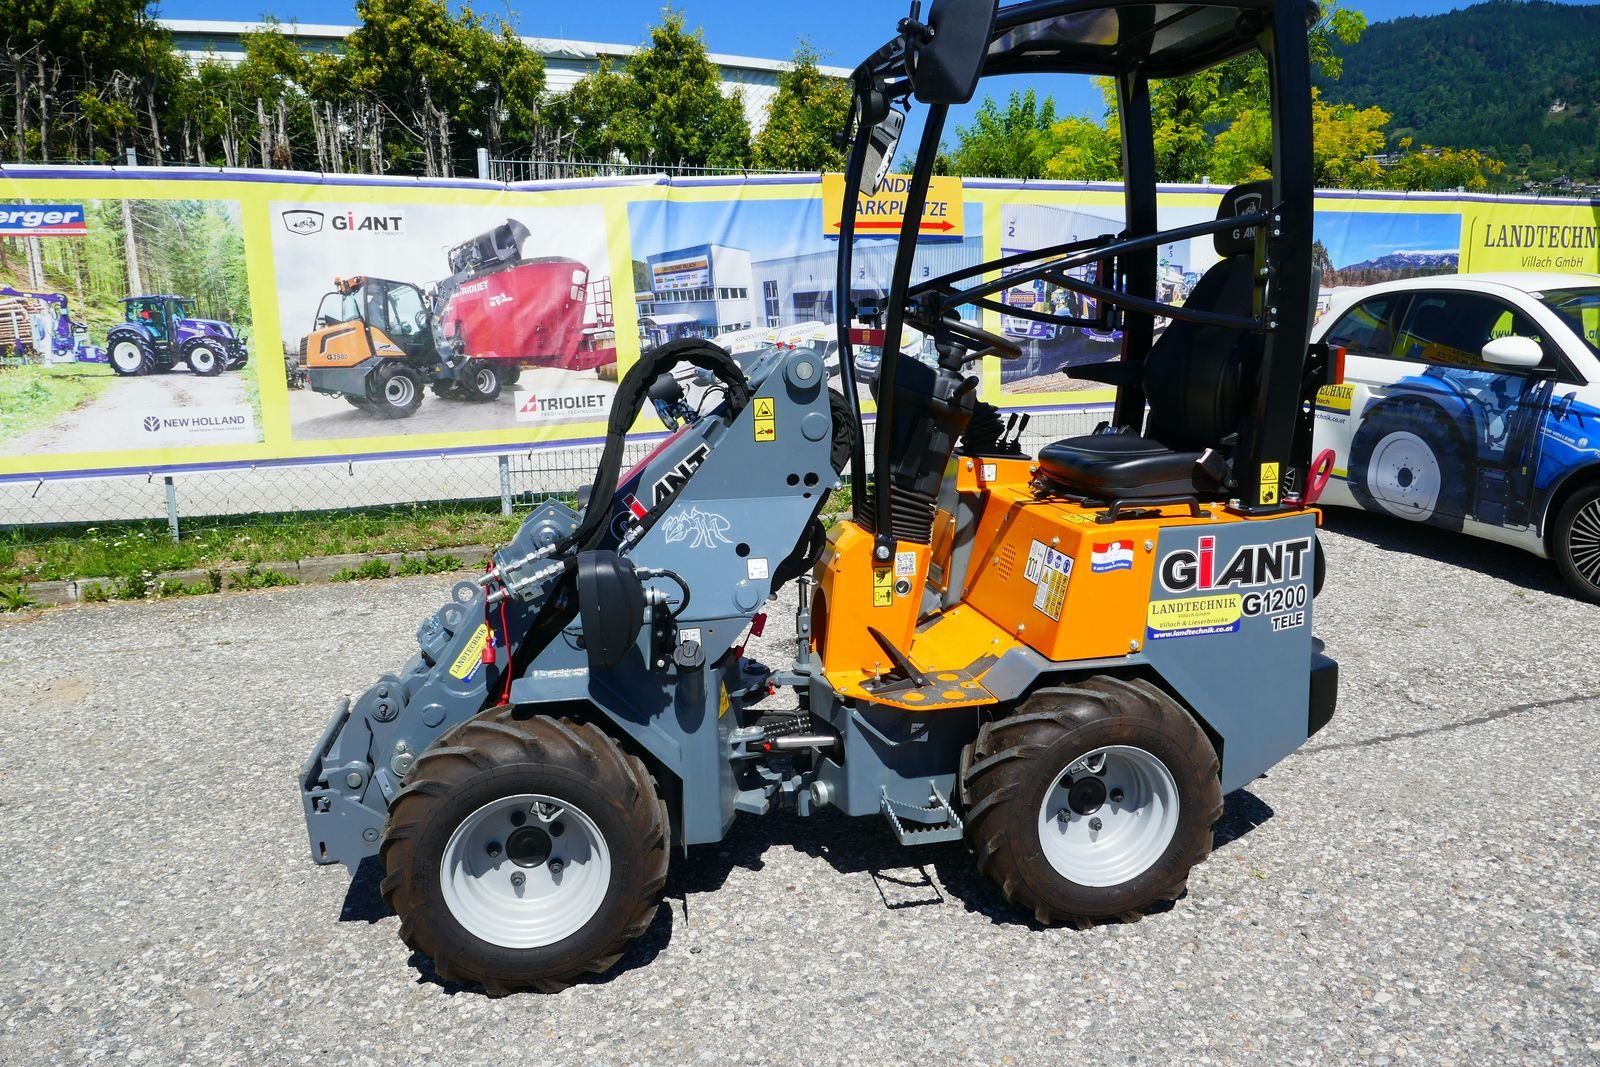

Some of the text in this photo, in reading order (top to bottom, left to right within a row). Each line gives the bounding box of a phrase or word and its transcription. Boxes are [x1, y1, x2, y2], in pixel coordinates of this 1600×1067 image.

[856, 200, 948, 217] ARKPLTZE
[1008, 227, 1016, 237] 2
[1484, 223, 1600, 249] LANDTECHN
[1521, 256, 1584, 268] Villach GmbH
[922, 266, 930, 277] 3
[538, 394, 606, 411] TRIOLIET
[164, 415, 245, 428] NEW HOLLAND
[1152, 598, 1237, 615] LANDTECHNIK
[1241, 584, 1308, 618] G1200
[1188, 617, 1229, 626] Lieserbrücke
[1272, 611, 1305, 632] TELE
[1153, 625, 1234, 639] www.landtechnik.co.at
[451, 628, 487, 674] LANDTECHNIK
